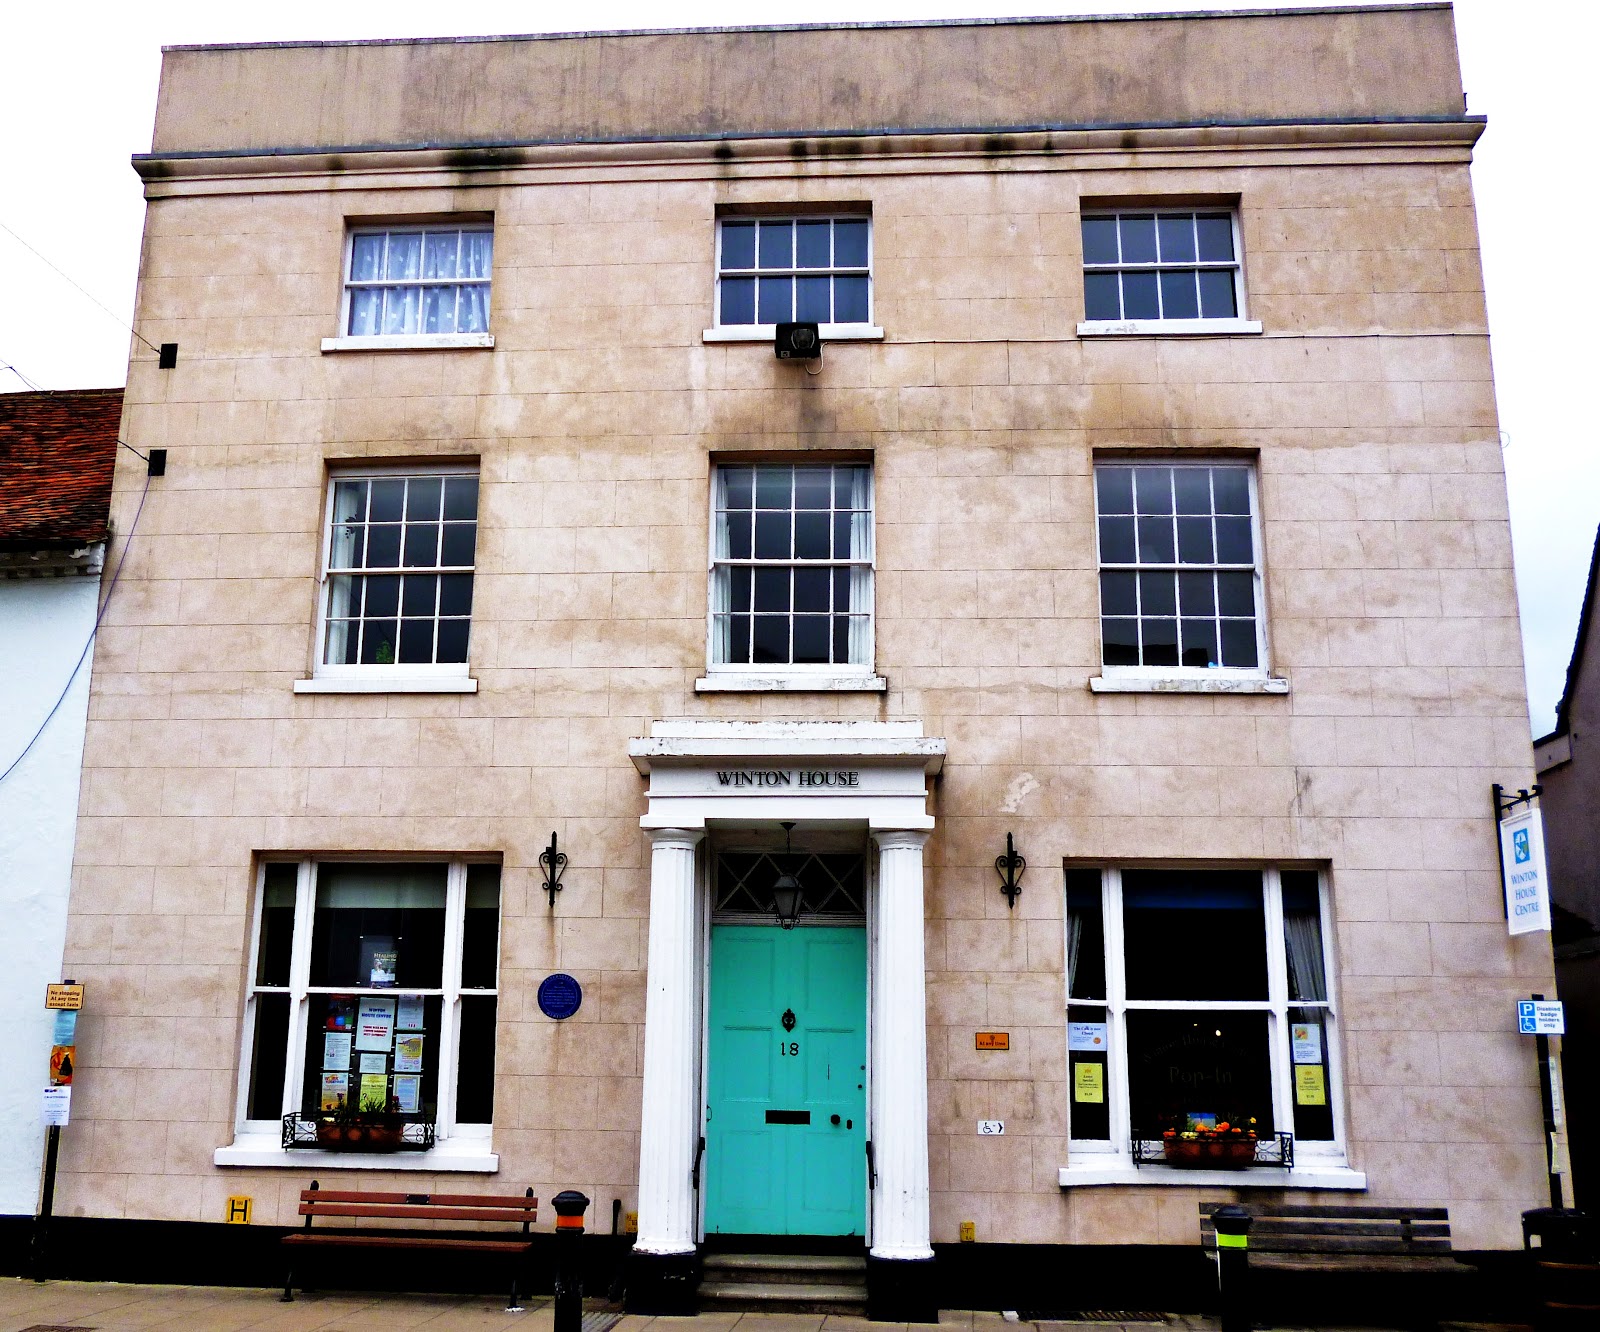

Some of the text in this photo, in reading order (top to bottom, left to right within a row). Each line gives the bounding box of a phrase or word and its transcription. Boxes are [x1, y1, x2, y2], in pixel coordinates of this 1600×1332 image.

[716, 770, 860, 787] WINTON HOUSE
[1511, 869, 1538, 885] WINTON
[1515, 885, 1537, 901] HOUSE
[1515, 901, 1539, 916] CENTRE
[1523, 1003, 1533, 1016] P
[781, 1042, 799, 1057] 18
